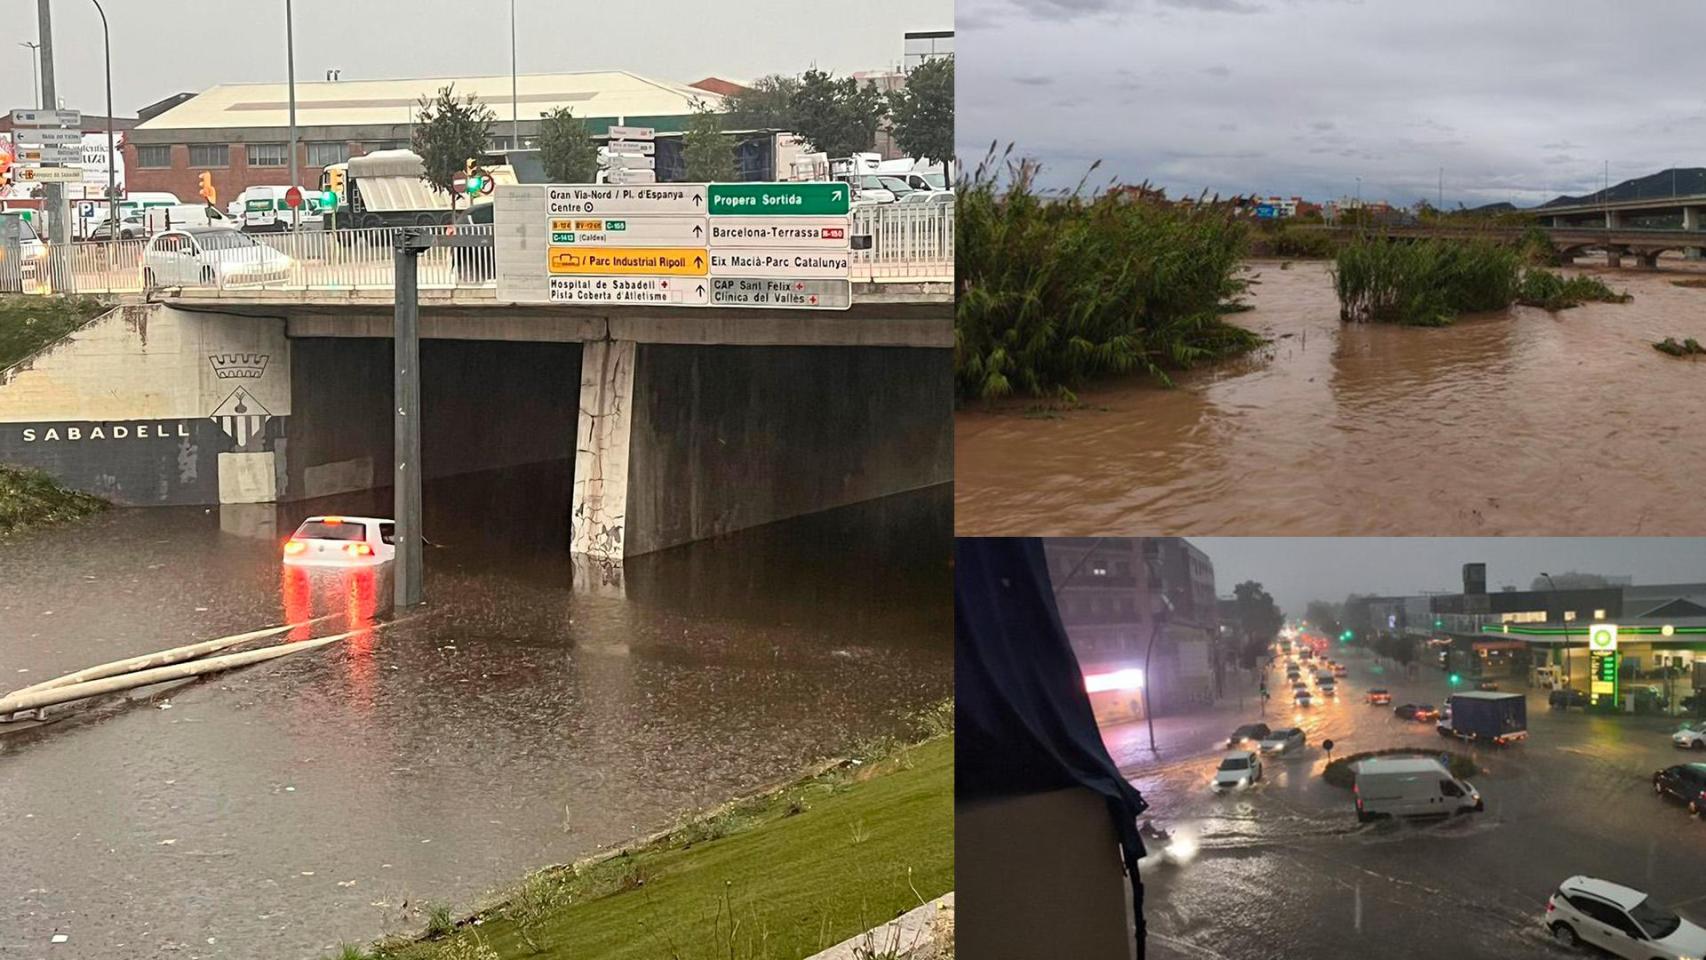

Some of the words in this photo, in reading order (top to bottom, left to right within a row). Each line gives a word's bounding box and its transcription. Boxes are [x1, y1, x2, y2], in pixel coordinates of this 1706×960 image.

[550, 190, 570, 199] Gran
[574, 190, 612, 199] Via-Nord
[623, 190, 634, 199] Pl.
[638, 190, 684, 200] d'Espanya
[714, 195, 756, 207] Propera
[762, 194, 802, 205] Sortida
[551, 203, 581, 212] Centre
[713, 227, 819, 238] Barcelona-Terrassa
[579, 234, 606, 242] (Caldes)
[590, 256, 610, 265] Parc
[613, 257, 656, 266] Industrial
[660, 257, 686, 268] Ripoll
[712, 256, 726, 266] Eix
[732, 256, 789, 267] Macià-Parc
[794, 256, 847, 269] Catalunya
[551, 280, 590, 290] Hospital
[596, 280, 606, 289] de
[613, 280, 655, 289] Sabadell
[714, 280, 734, 289] CAP
[740, 280, 762, 290] Sant
[551, 291, 573, 300] Pista
[578, 291, 611, 300] Coberta
[616, 291, 667, 300] d'Atletisme
[754, 293, 769, 302] del
[774, 293, 805, 303] Vallès
[24, 424, 189, 442] SABADELL
